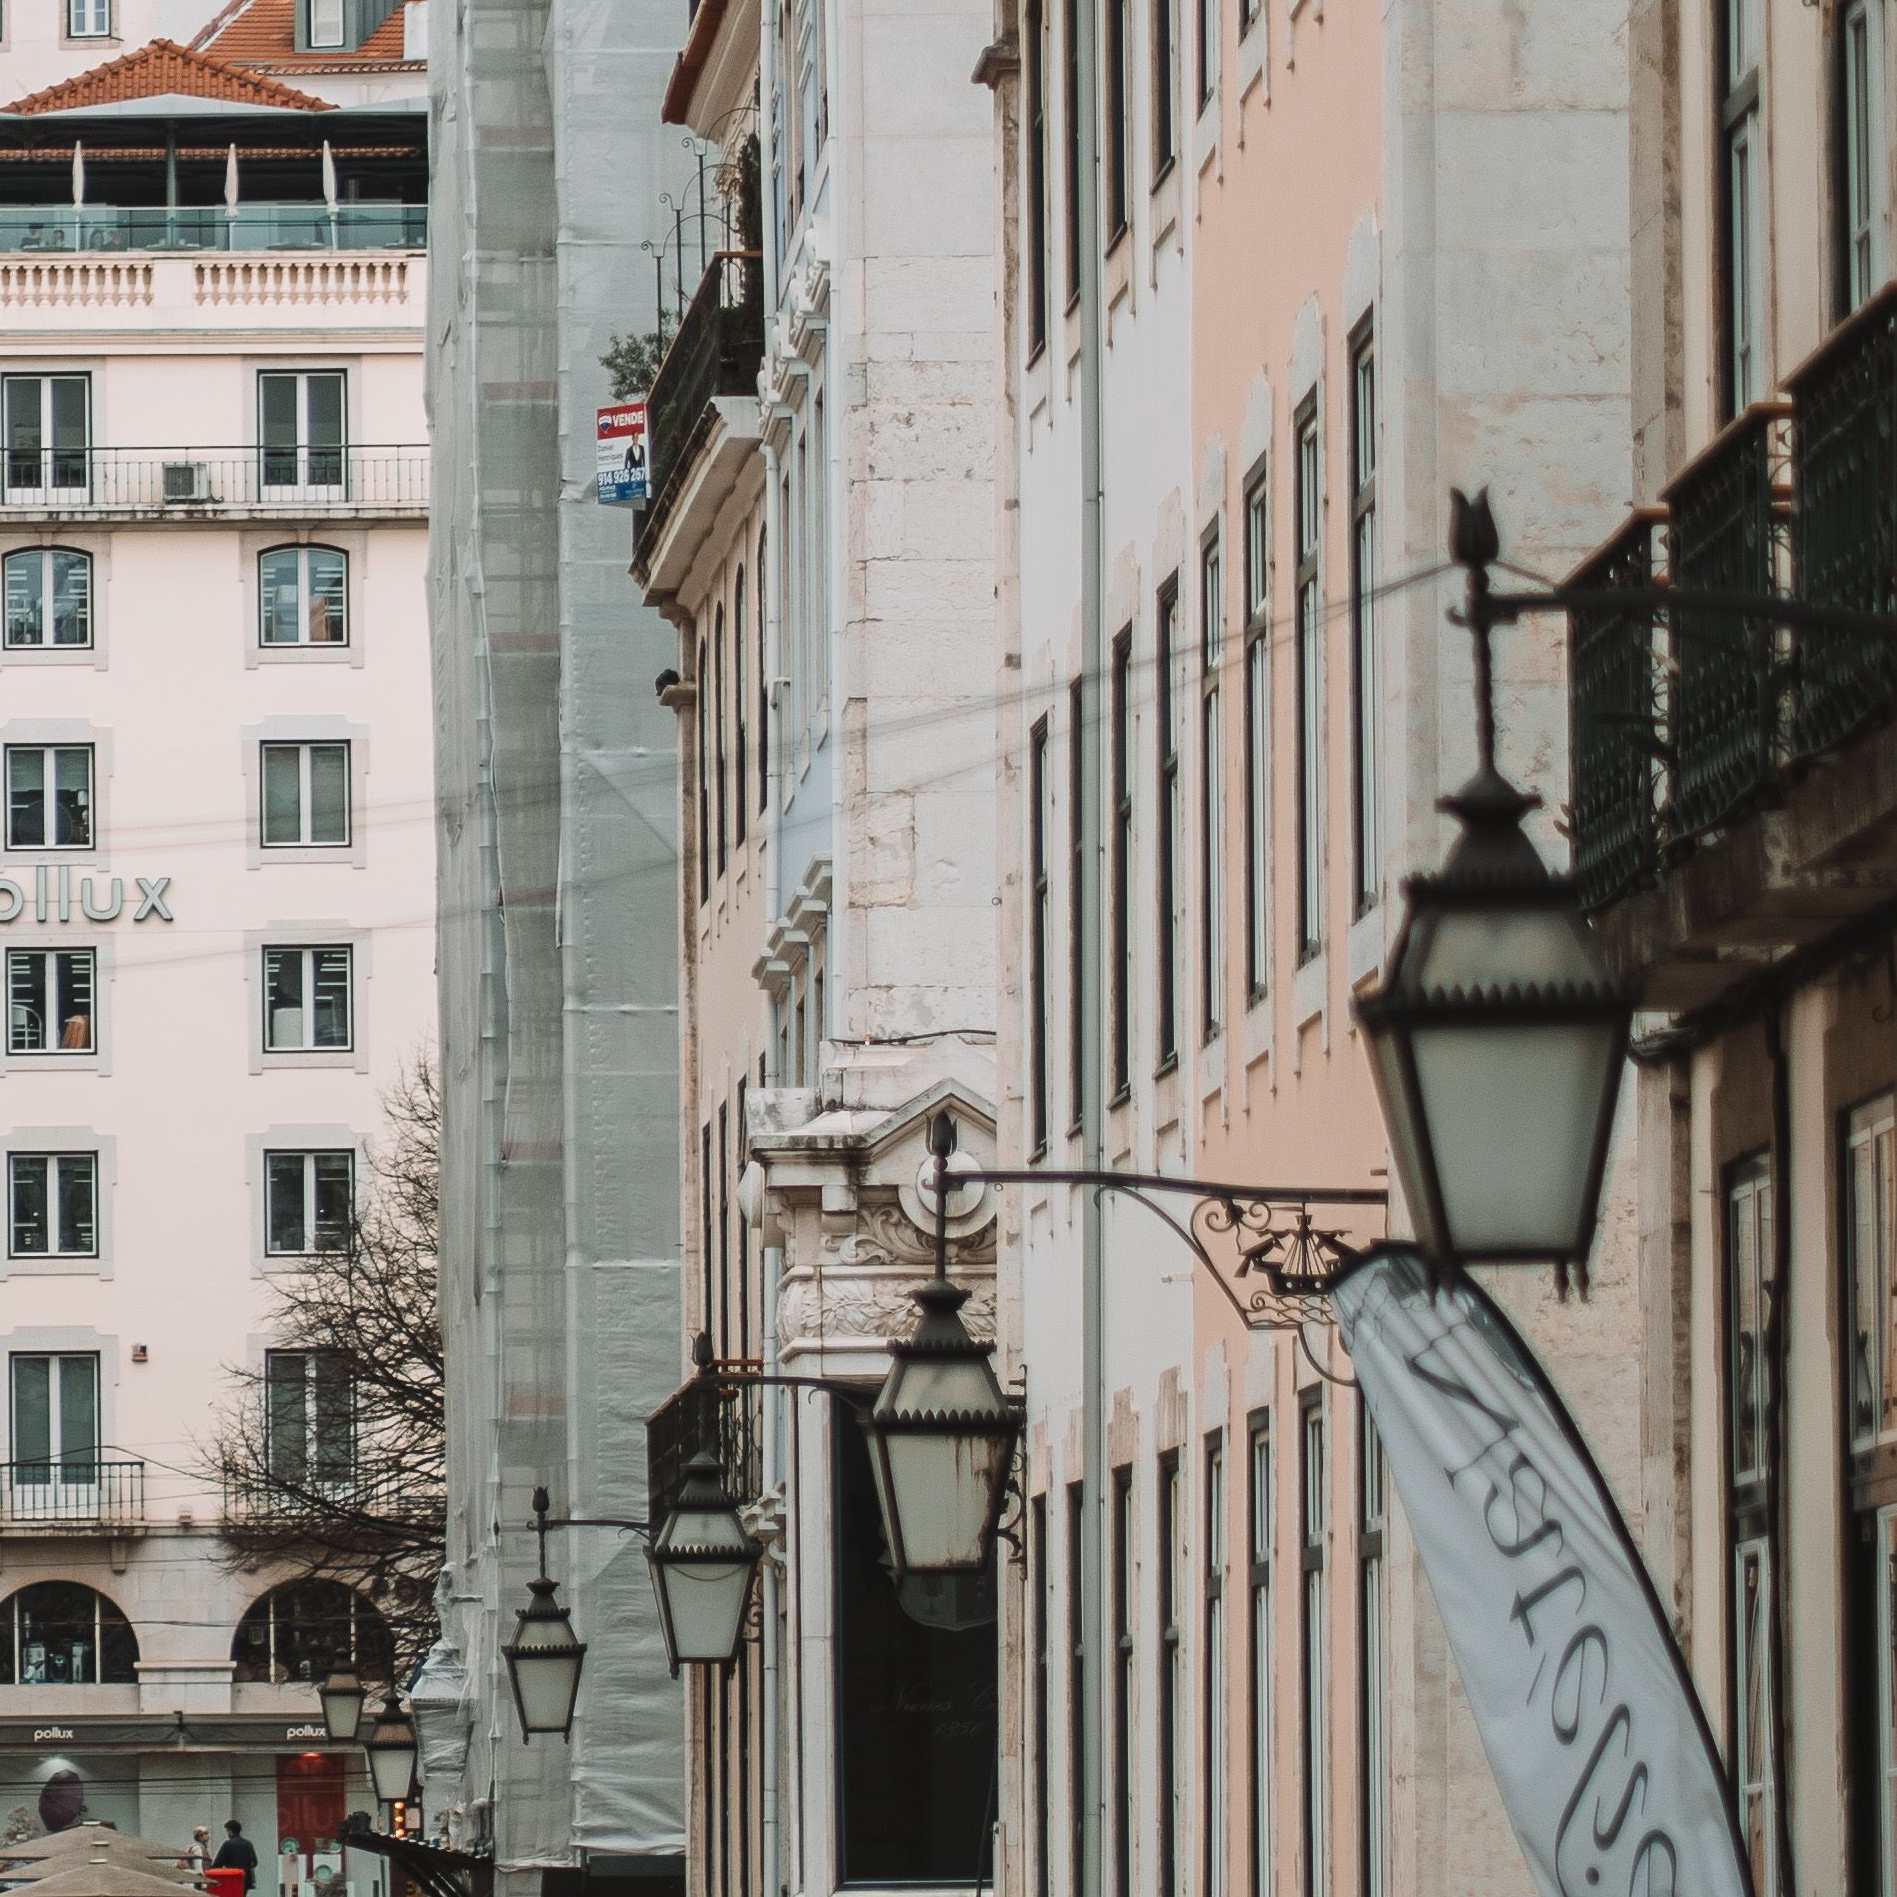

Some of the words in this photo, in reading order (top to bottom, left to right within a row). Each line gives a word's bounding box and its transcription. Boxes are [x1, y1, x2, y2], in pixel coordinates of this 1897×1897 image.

[612, 411, 644, 428] VENDE
[33, 1726, 74, 1743] pollux
[286, 1724, 327, 1741] pollux
